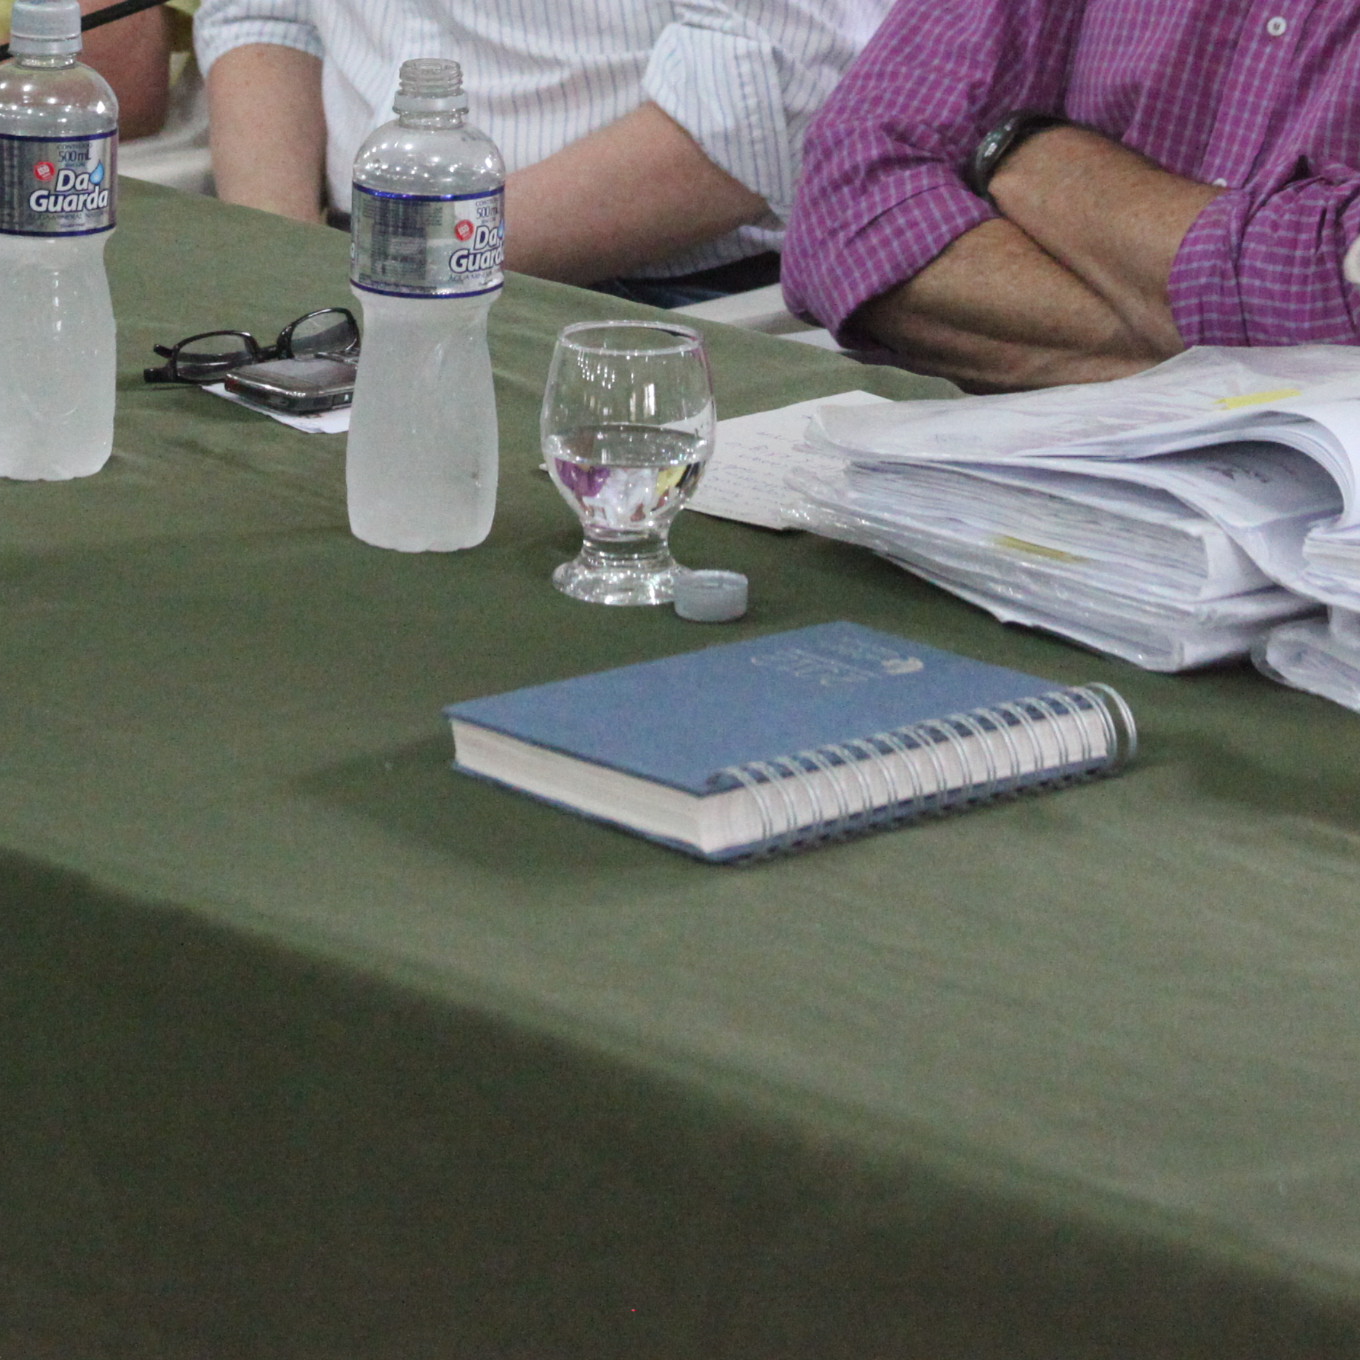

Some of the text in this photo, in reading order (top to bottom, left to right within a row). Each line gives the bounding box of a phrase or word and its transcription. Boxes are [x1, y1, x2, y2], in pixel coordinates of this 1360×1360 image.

[55, 168, 90, 193] Da
[29, 186, 109, 214] Guarda
[474, 225, 500, 251] Da
[448, 243, 504, 275] Guard
